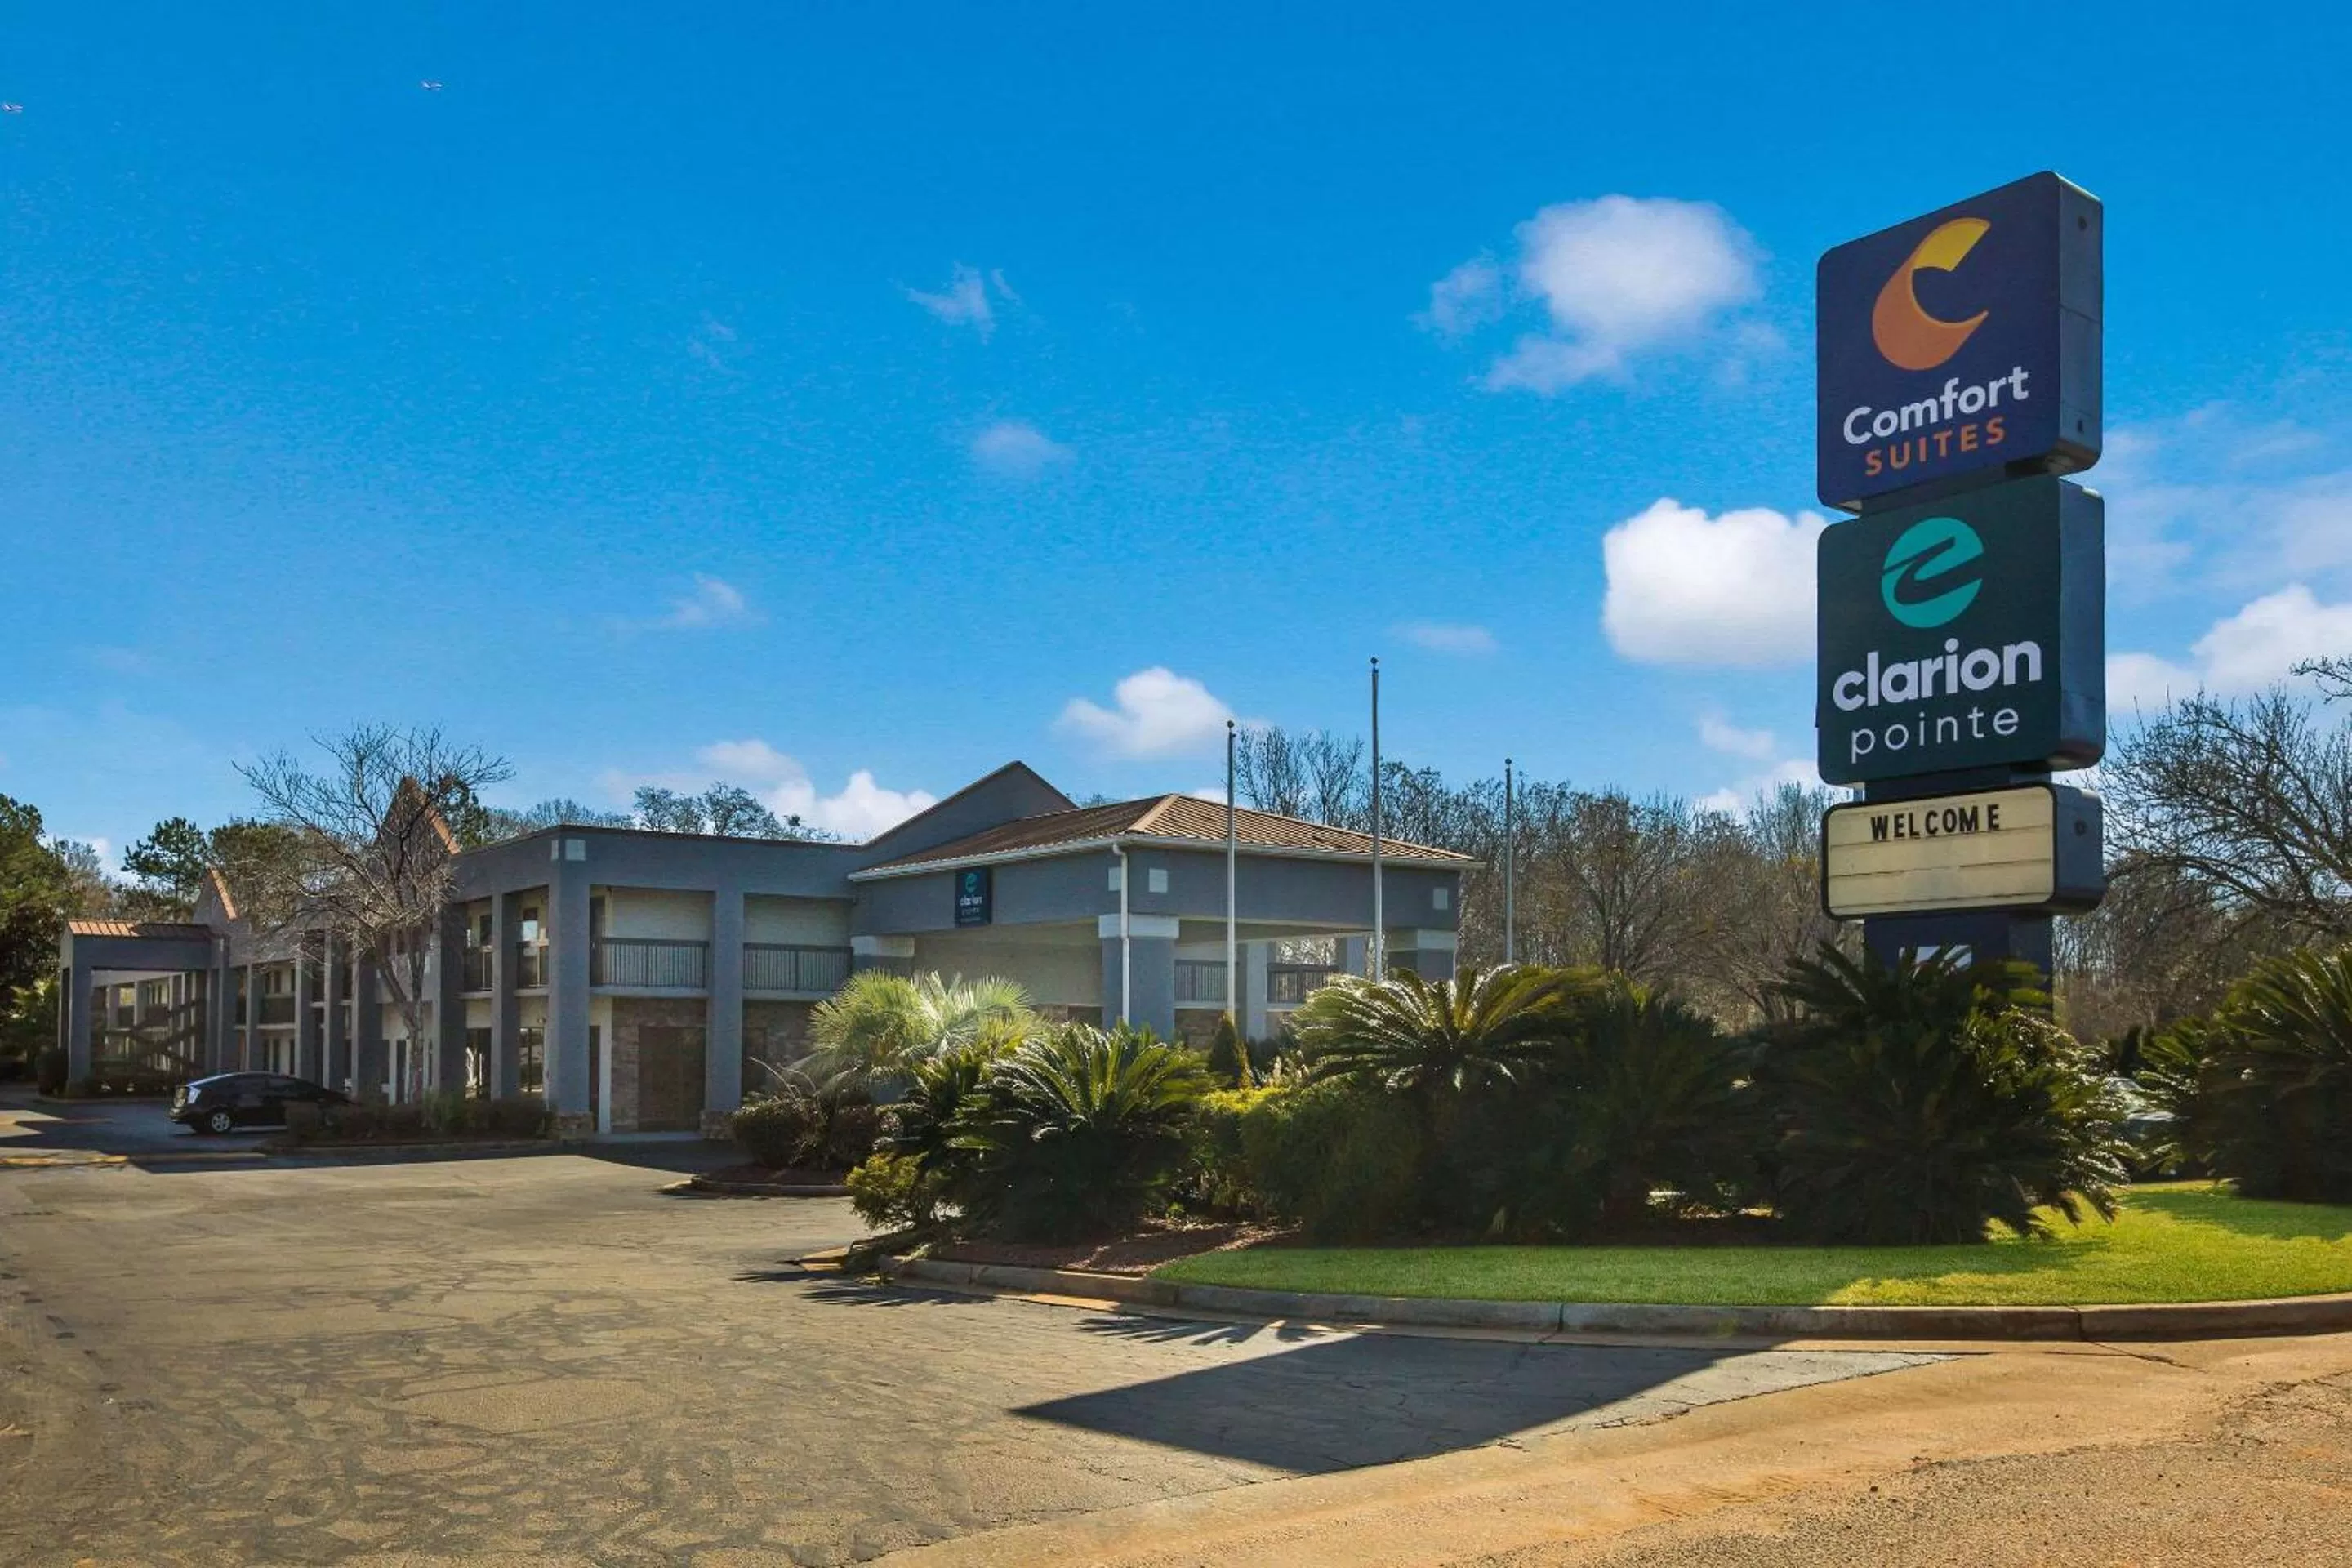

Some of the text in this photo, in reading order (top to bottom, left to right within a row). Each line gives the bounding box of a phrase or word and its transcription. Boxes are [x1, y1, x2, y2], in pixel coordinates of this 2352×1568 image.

[1843, 366, 2029, 444] Comfort
[1865, 416, 2006, 475] SUITES
[1833, 638, 2042, 711] clarion
[1851, 707, 2019, 764] pointe
[1871, 804, 2000, 840] WELCOME
